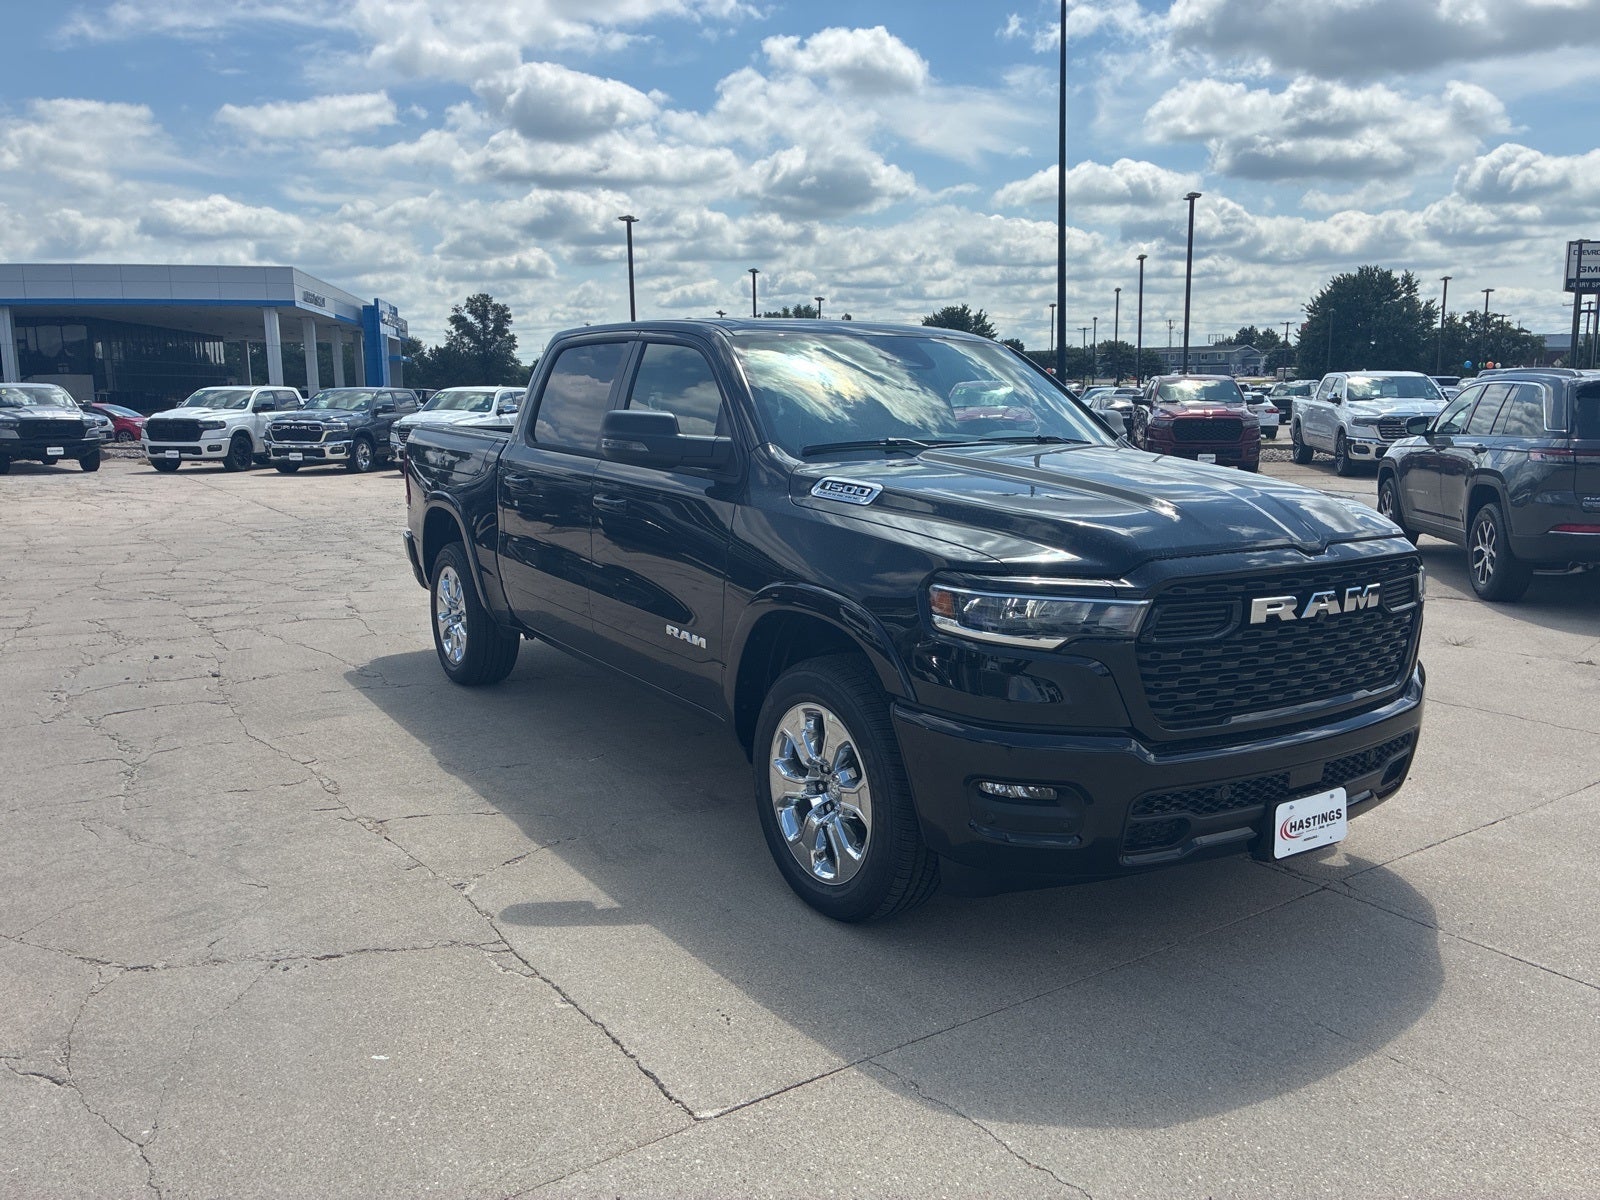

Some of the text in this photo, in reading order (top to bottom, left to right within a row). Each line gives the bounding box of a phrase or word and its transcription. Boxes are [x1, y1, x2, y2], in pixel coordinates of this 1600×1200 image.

[1579, 265, 1600, 273] GM
[821, 481, 872, 497] 1500
[1250, 583, 1380, 624] RAM
[665, 624, 706, 649] RAM
[1289, 808, 1342, 833] HASTINGS
